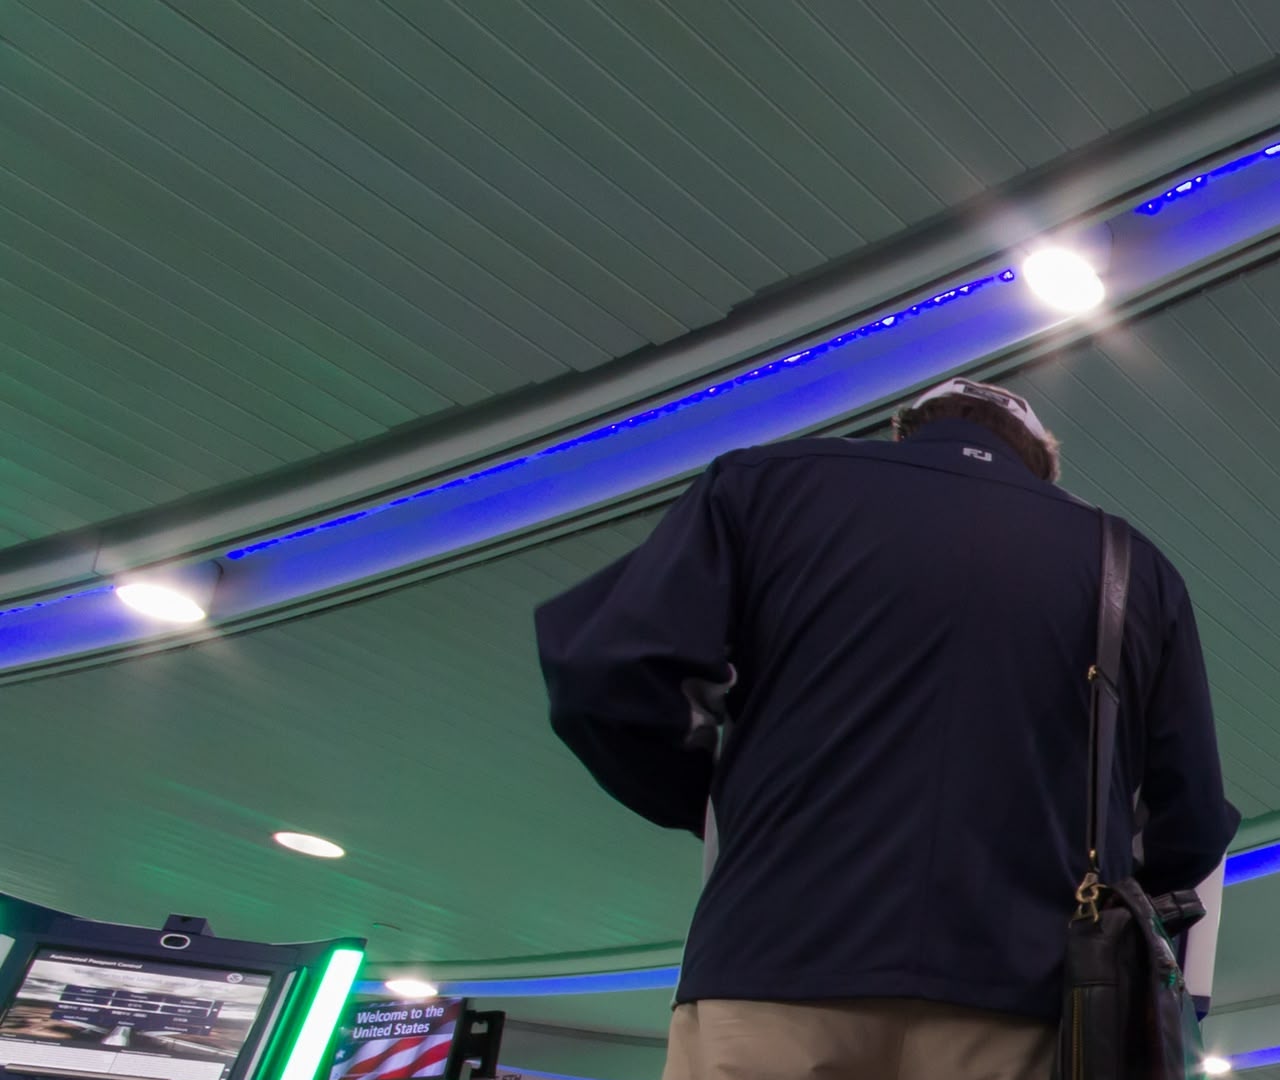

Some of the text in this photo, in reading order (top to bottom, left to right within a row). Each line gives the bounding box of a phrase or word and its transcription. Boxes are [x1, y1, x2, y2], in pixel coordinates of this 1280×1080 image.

[357, 1005, 444, 1025] Welcome to the
[352, 1021, 430, 1039] United States
